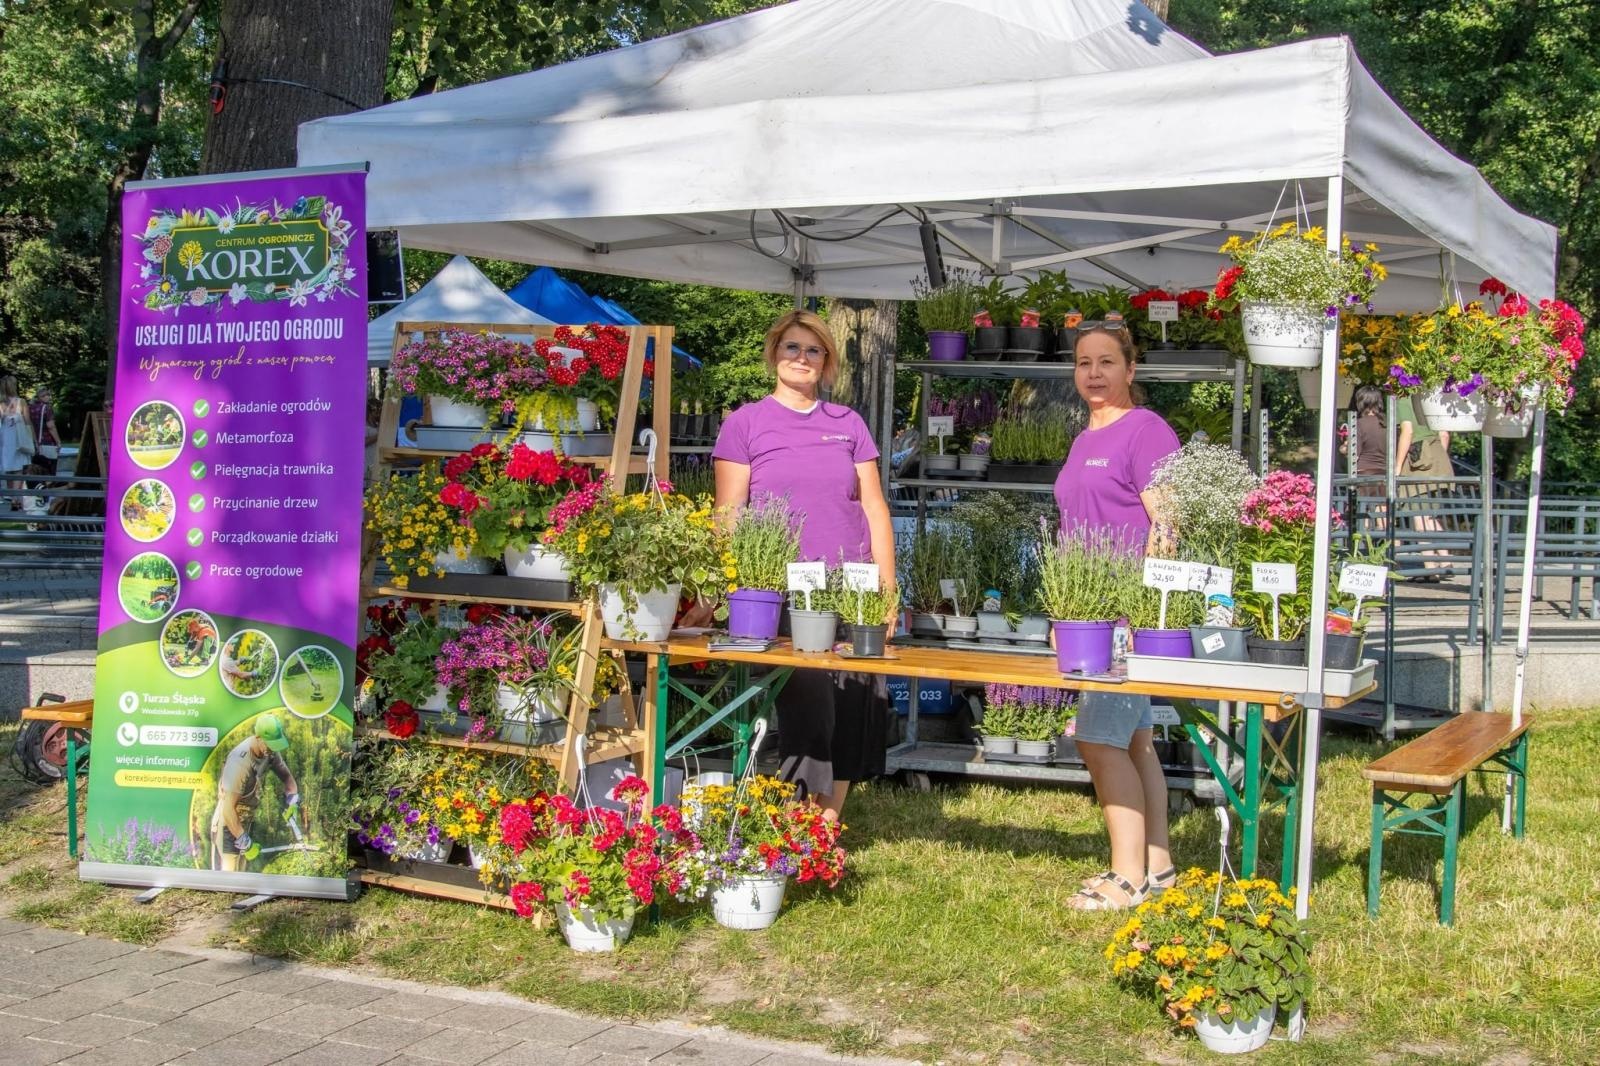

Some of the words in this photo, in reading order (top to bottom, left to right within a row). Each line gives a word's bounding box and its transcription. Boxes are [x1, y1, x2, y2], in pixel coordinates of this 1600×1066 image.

[215, 238, 256, 247] CENTRUM
[258, 233, 316, 244] OGRODNICZE
[185, 246, 315, 281] KOREX
[135, 325, 184, 347] USŁUGI
[187, 323, 213, 345] DLA
[216, 320, 280, 343] TWOJEGO
[284, 317, 344, 340] OGRODU
[139, 355, 206, 382] Wymarzony
[210, 345, 246, 380] ogród
[247, 357, 253, 365] z
[256, 355, 290, 367] naszą
[291, 353, 337, 372] pomocą
[217, 399, 278, 414] Zakładanie
[280, 397, 332, 415] ogrodów
[215, 431, 295, 445] Metamorfoza
[214, 462, 280, 478] Pielęgnacja
[283, 463, 334, 476] trawnika
[212, 496, 281, 510] Przycinanie
[283, 495, 319, 509] drzew
[211, 531, 298, 545] Porządkowanie
[301, 530, 339, 544] działki
[209, 564, 243, 577] Prace
[245, 564, 303, 579] ogrodowe
[142, 693, 170, 704] Turza
[172, 691, 206, 706] Śląska
[920, 690, 942, 701] 033
[146, 730, 167, 742] 665
[169, 731, 189, 742] 773
[191, 732, 211, 743] 995
[115, 754, 144, 766] więcej
[145, 755, 190, 768] informacji
